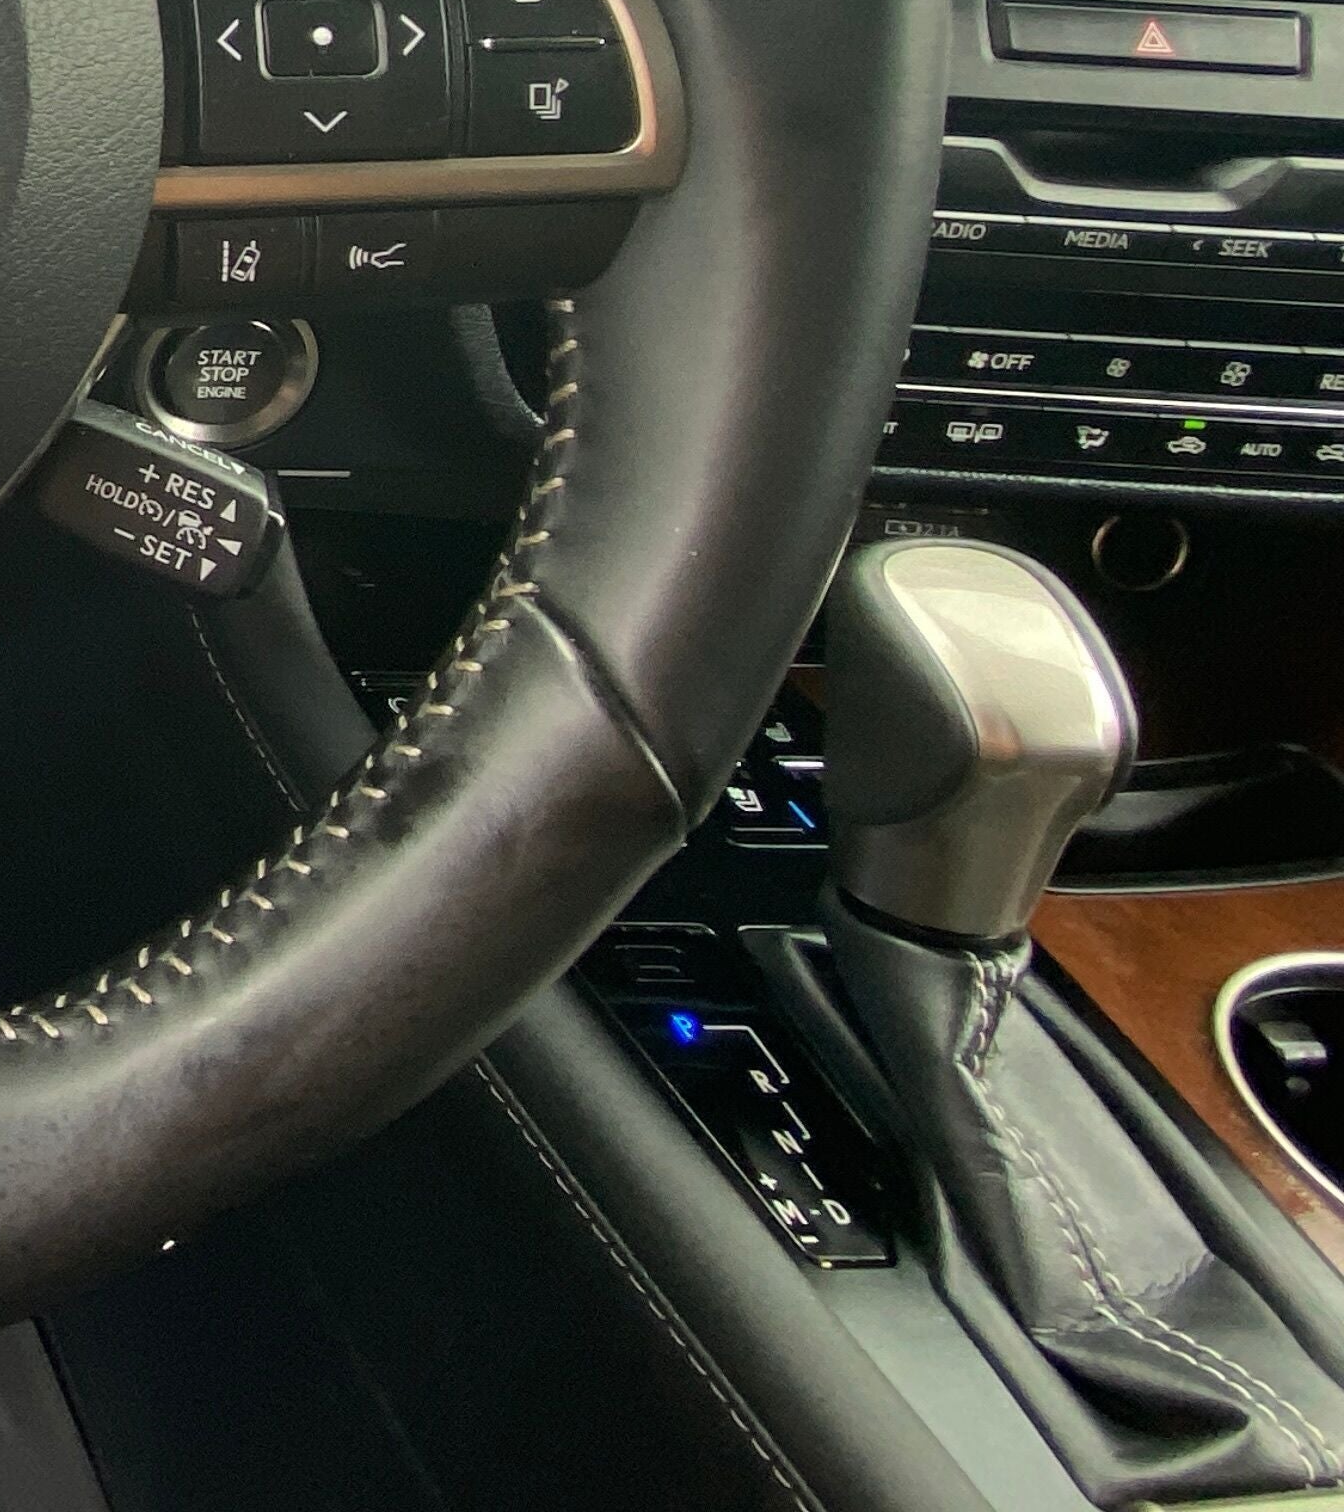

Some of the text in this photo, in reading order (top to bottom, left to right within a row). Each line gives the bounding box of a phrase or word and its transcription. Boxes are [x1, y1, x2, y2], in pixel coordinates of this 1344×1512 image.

[928, 221, 987, 240] ADIO
[1063, 229, 1130, 251] MEDIA
[1217, 238, 1273, 258] SEEK
[196, 349, 262, 366] START
[989, 353, 1036, 372] OFF
[198, 367, 250, 383] STOP
[196, 386, 248, 400] ENGINE
[134, 421, 234, 472] CANCEL
[1239, 442, 1283, 457] AUTO
[84, 473, 142, 511] HOLD
[164, 472, 217, 510] RES
[139, 534, 193, 571] SET
[669, 1013, 696, 1042] P
[747, 1069, 780, 1094] R
[771, 1129, 805, 1155] N
[770, 1199, 852, 1226] M D
